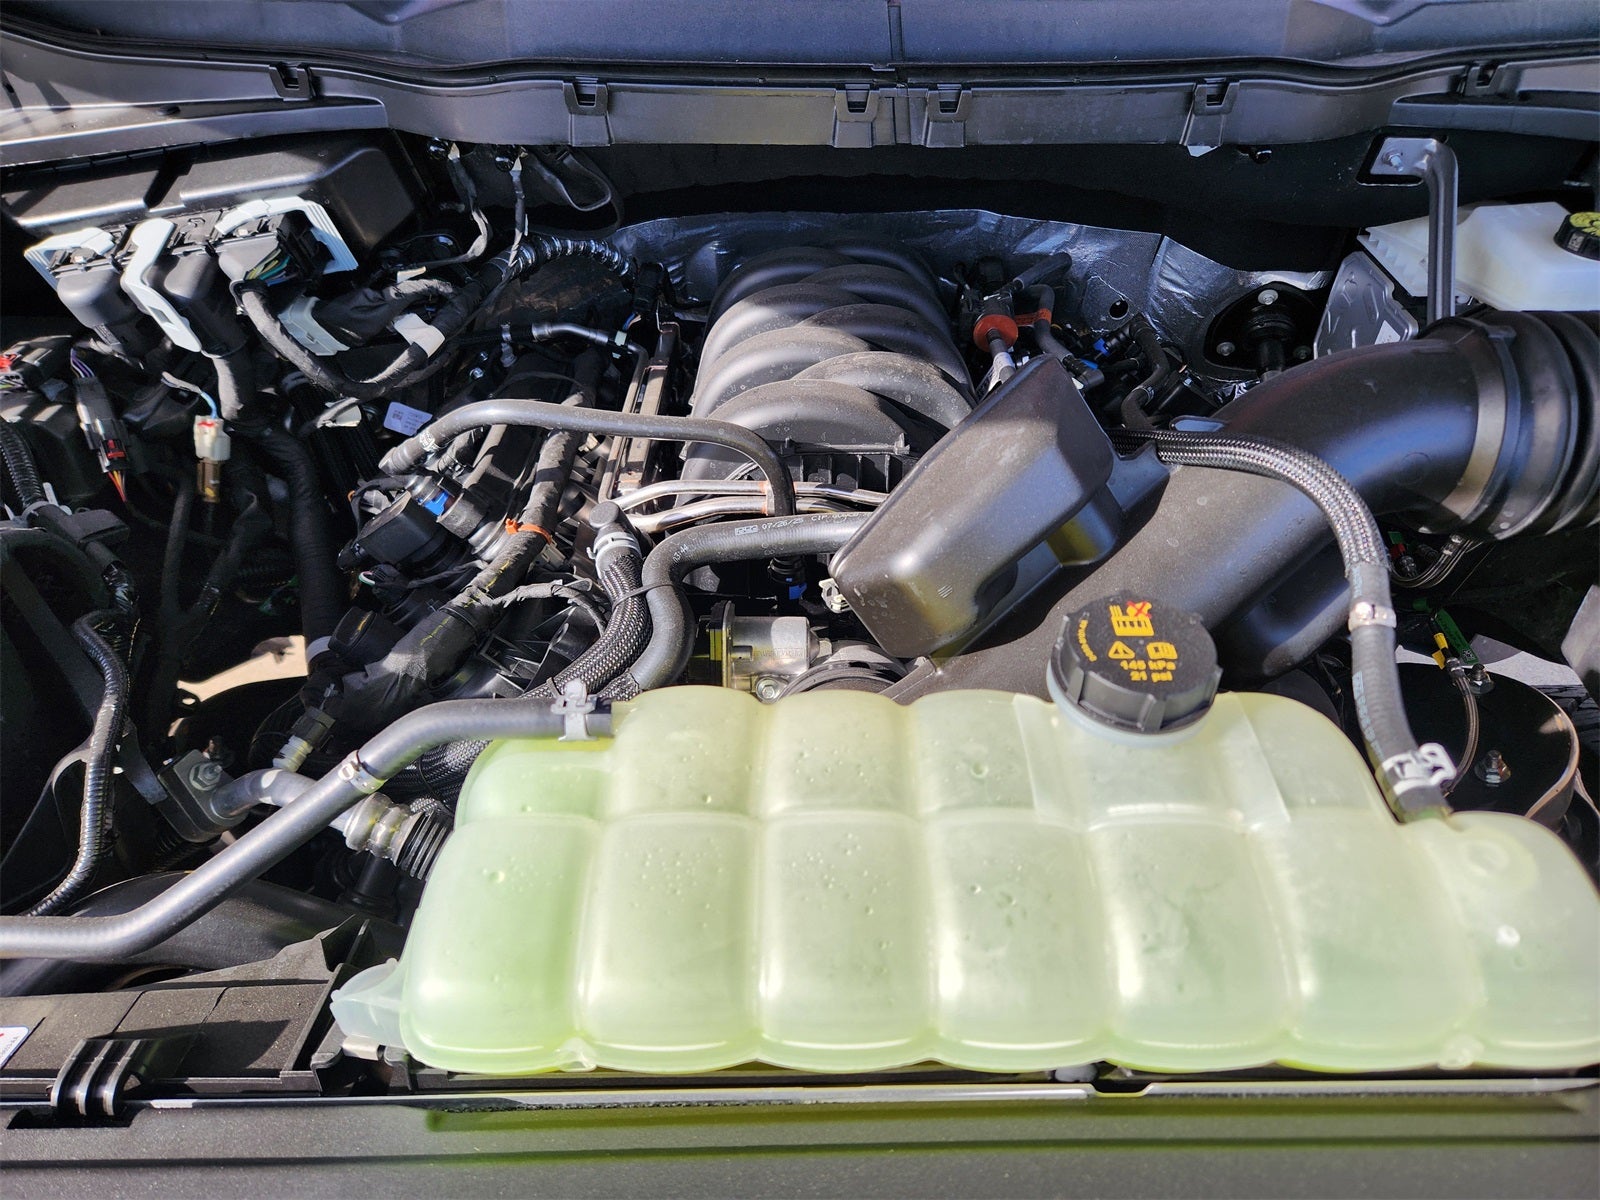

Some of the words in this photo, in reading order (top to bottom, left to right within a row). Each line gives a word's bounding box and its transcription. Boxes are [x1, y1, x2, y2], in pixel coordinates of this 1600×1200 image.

[1120, 660, 1146, 671] 145
[1148, 660, 1176, 671] kPa
[1130, 670, 1147, 681] 21
[1151, 670, 1173, 683] psi
